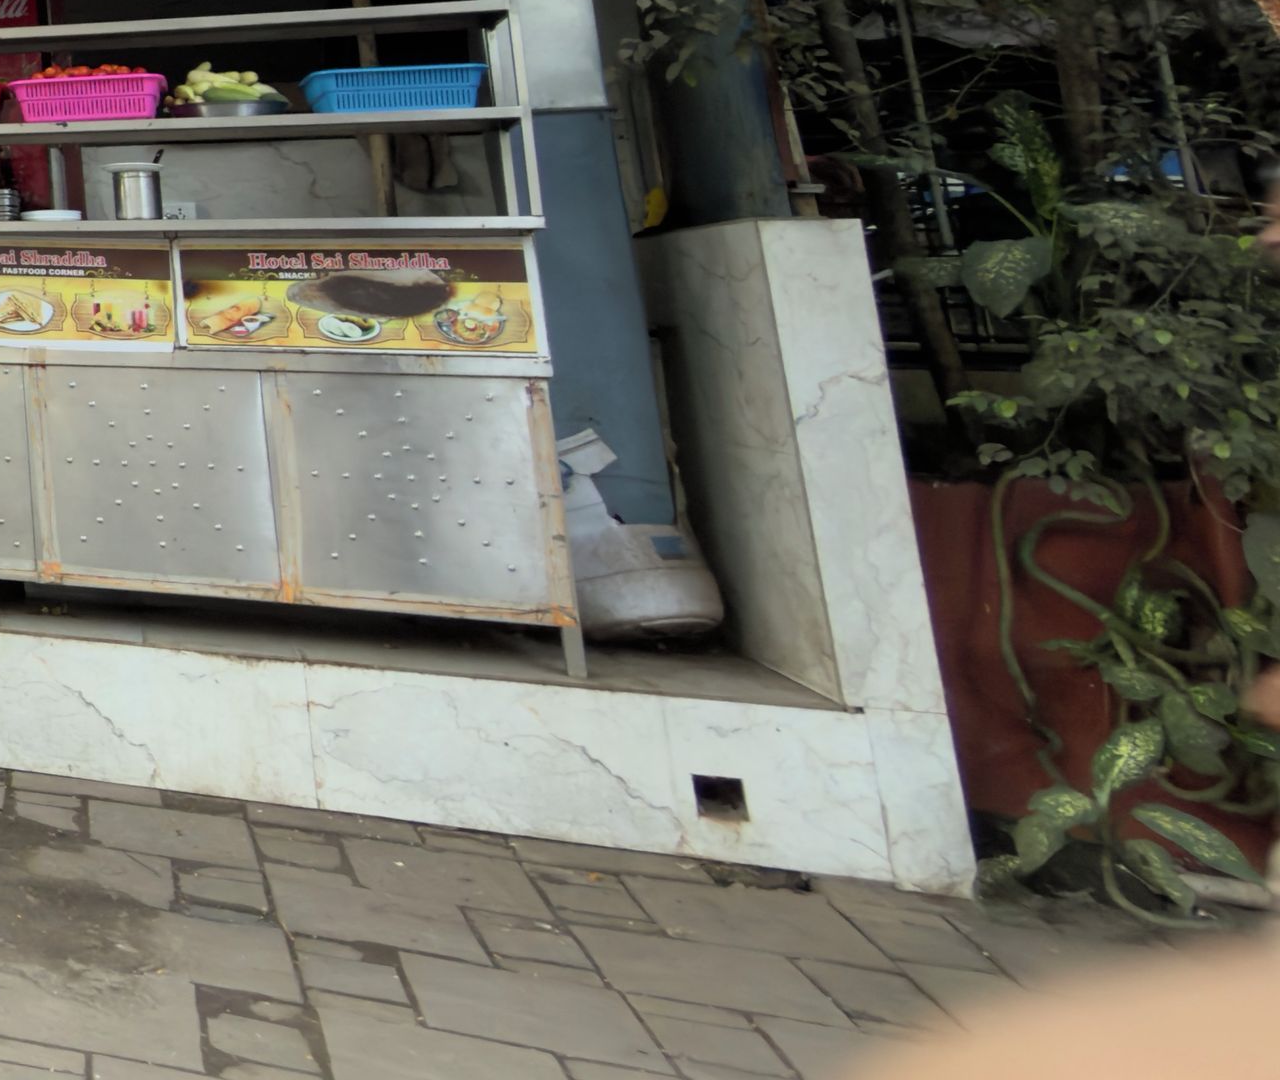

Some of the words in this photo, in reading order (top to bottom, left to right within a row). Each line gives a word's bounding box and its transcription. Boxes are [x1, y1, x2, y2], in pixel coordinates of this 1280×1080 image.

[20, 248, 107, 267] Shraddha
[248, 252, 306, 270] Hotel
[311, 251, 344, 270] Sai
[347, 251, 451, 270] Shraddha
[2, 266, 47, 276] FASTFOOD
[48, 268, 85, 277] CORNER
